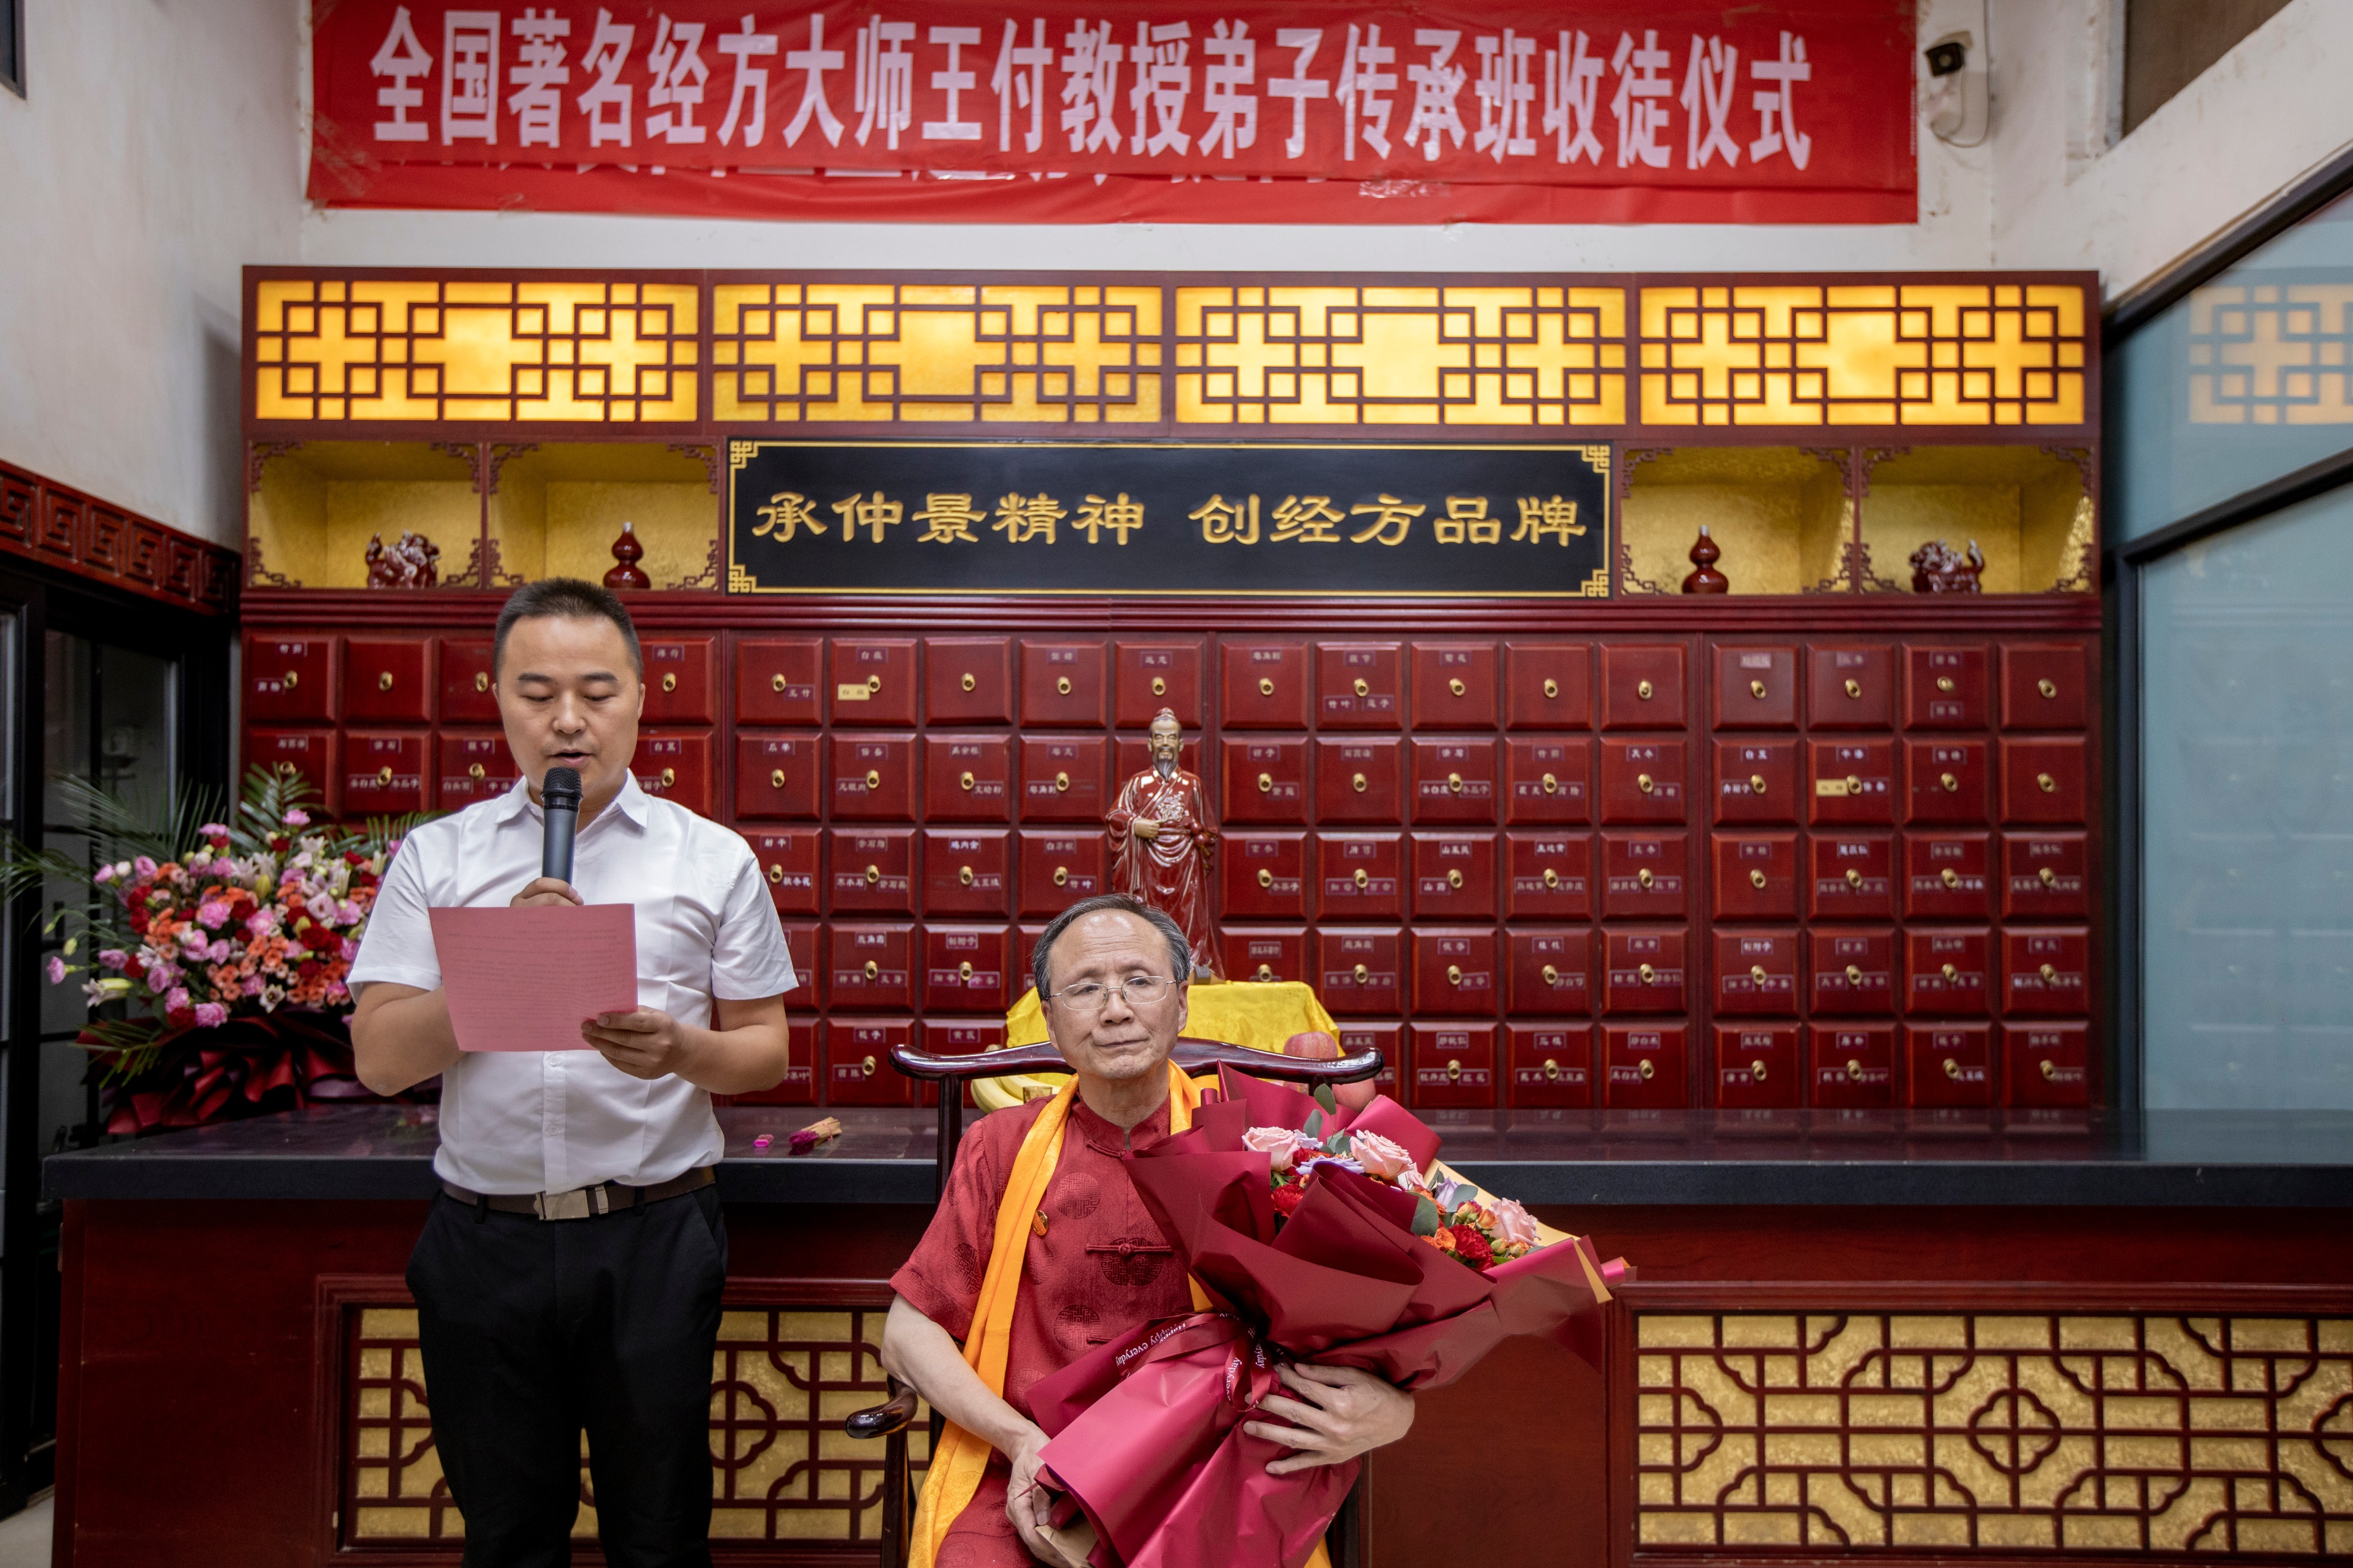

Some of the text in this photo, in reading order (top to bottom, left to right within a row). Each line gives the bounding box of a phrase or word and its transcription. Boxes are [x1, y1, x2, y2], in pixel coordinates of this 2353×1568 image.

[369, 5, 1812, 170] 全国著名经方大师王付教授弟子传承班收徒仪式
[752, 492, 1586, 546] 承仲景精神 创经方品牌
[1115, 1342, 1148, 1367] everyday
[1159, 1322, 1186, 1344] Happy
[1226, 1357, 1243, 1401] everyday
